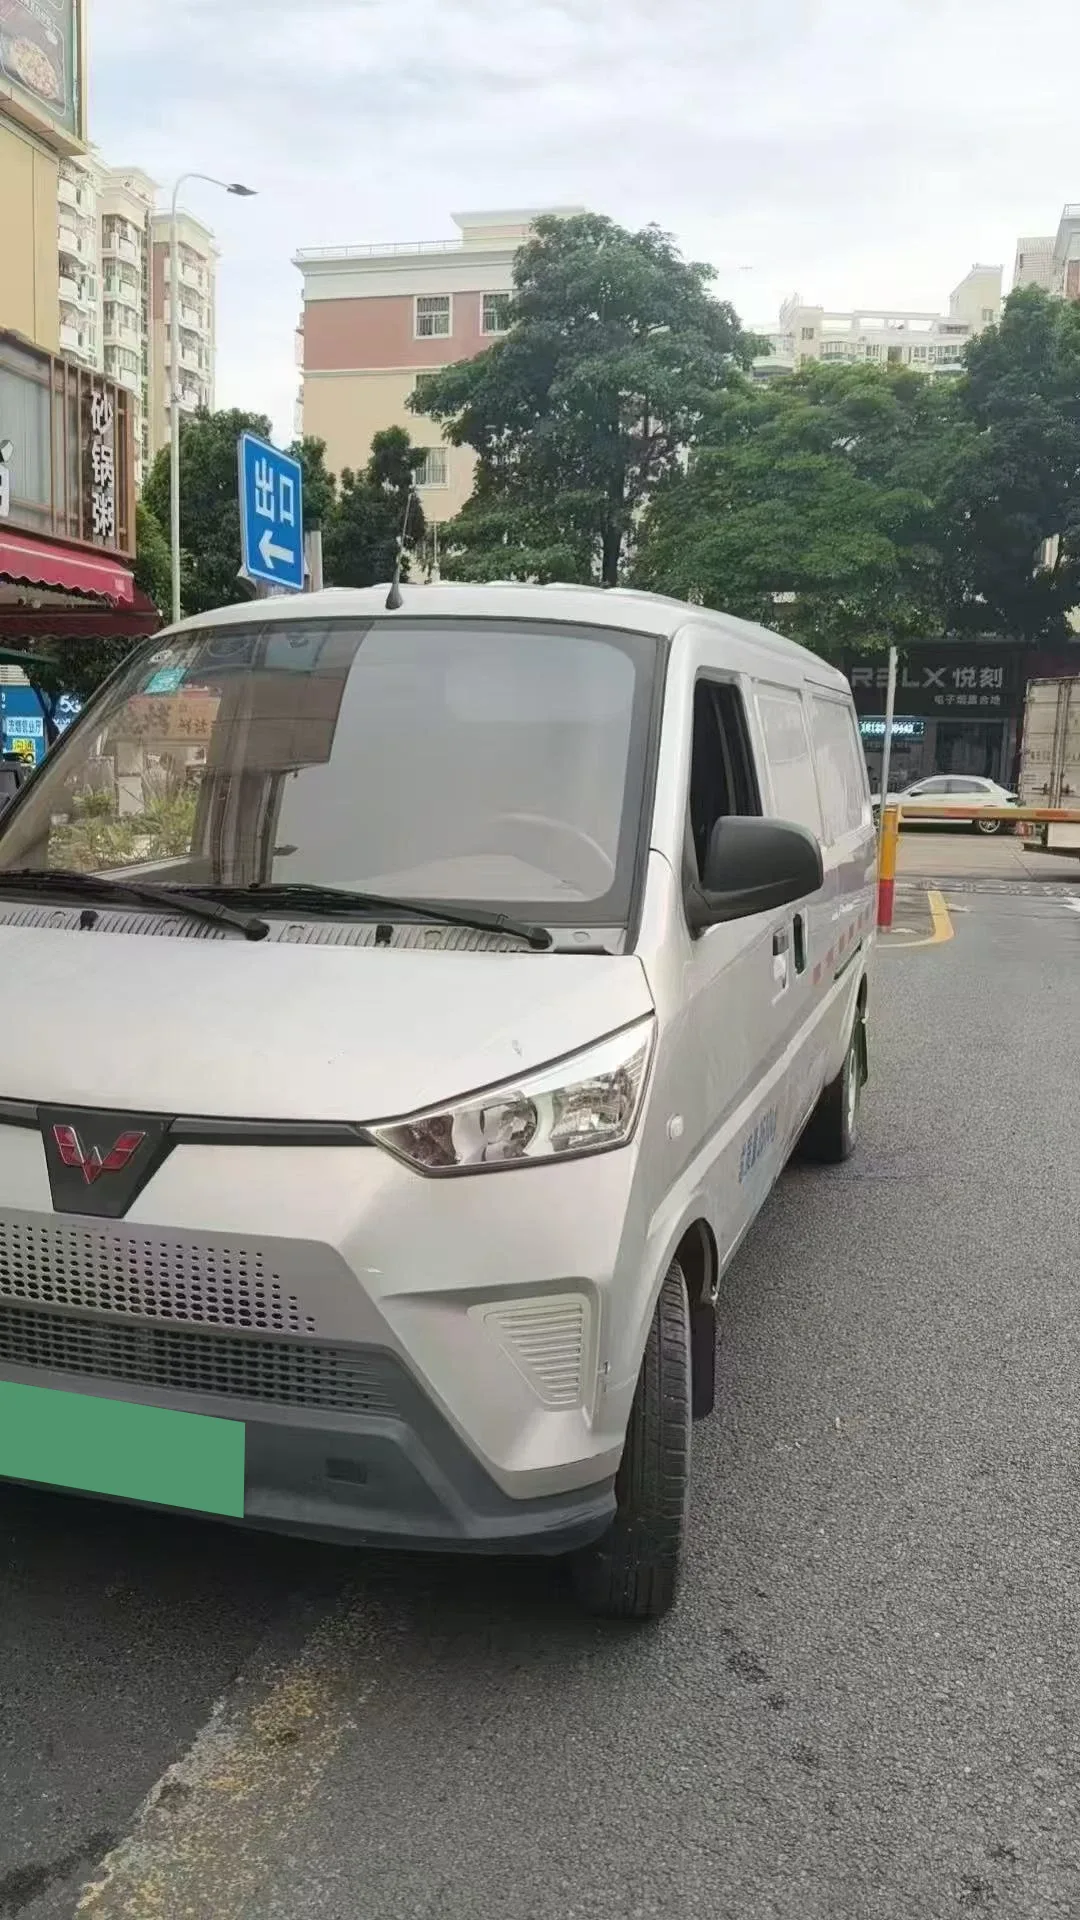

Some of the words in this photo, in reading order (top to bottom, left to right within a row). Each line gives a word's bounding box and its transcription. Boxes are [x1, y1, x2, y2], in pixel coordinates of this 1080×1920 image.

[91, 391, 115, 537] 砂锅粥
[255, 457, 294, 527] 出口
[952, 666, 1003, 688] 悦刻
